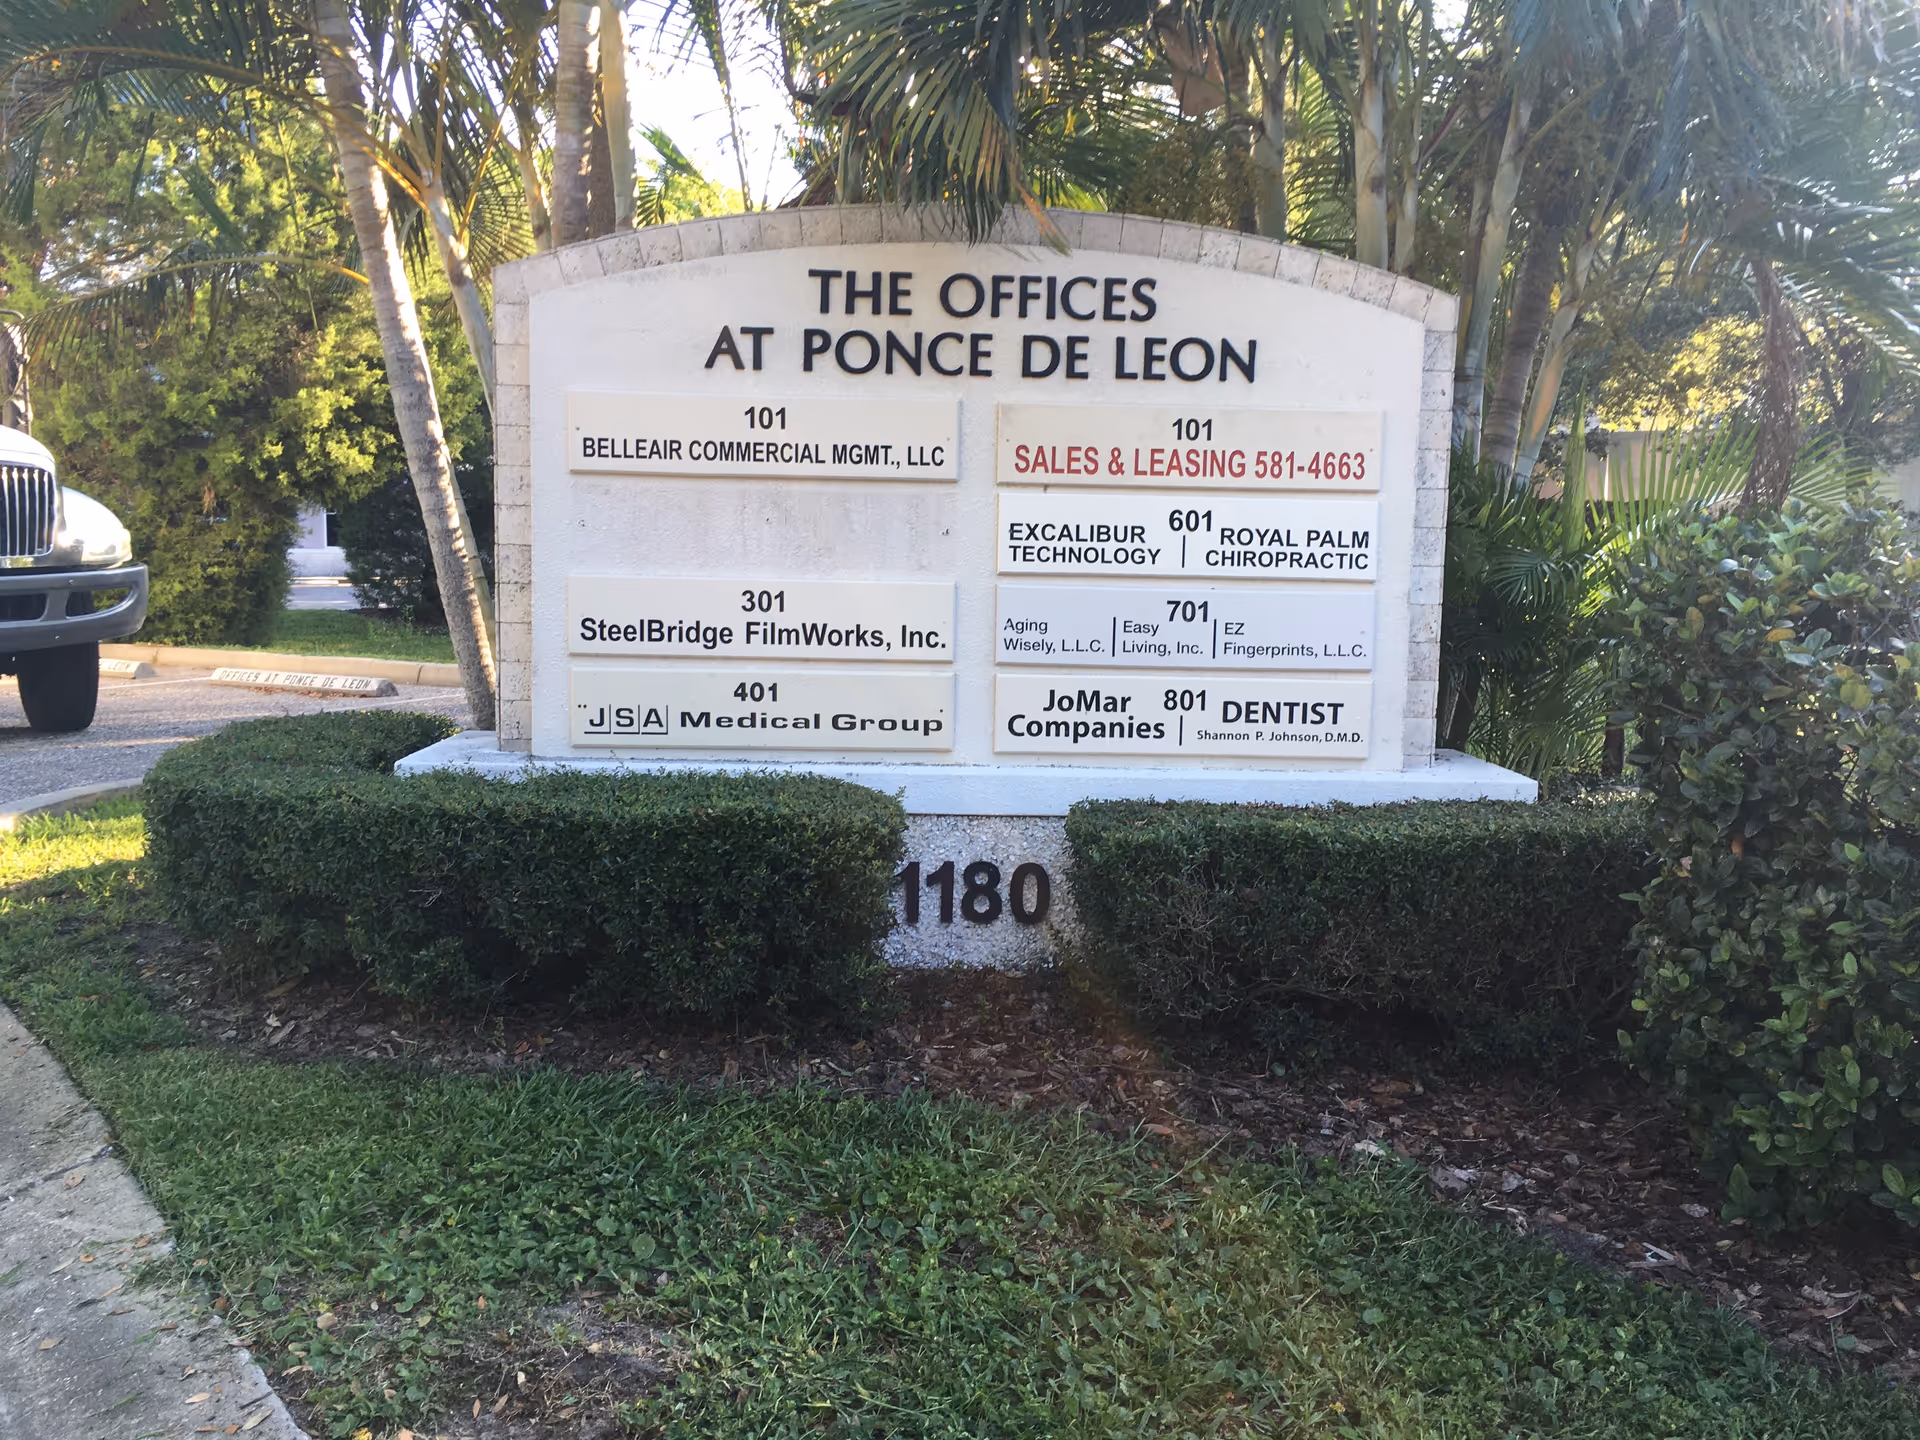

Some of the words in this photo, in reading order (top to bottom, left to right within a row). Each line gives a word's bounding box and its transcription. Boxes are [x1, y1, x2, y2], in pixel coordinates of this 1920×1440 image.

[807, 268, 913, 317] THE
[938, 272, 1157, 323] OFFICES
[704, 325, 775, 372] AT
[802, 328, 994, 378] PONCE
[1021, 334, 1090, 380] DE
[1114, 336, 1258, 384] LEON
[744, 406, 786, 430] 101
[1172, 417, 1213, 442] 101
[582, 437, 683, 461] BELLEAIR
[688, 439, 826, 464] COMMERCIAL
[832, 443, 901, 470] MGMT.,
[907, 445, 945, 467] LLC
[1014, 444, 1099, 476] SALES
[1107, 446, 1126, 476] &
[1133, 447, 1246, 479] LEASING
[1254, 450, 1365, 481] 581-4663
[1008, 522, 1146, 544] EXCALIBUR
[1168, 509, 1212, 533] 601
[1220, 527, 1299, 547] ROYAL
[1306, 529, 1370, 549] PALM
[1008, 545, 1162, 565] TECHNOLOGY
[1205, 549, 1369, 570] CHIROPRACTIC
[741, 589, 785, 613] 301
[1166, 600, 1209, 623] 701
[580, 617, 734, 650] SteelBridge
[745, 621, 891, 652] FilmWorks,
[901, 624, 946, 649] Inc.
[1003, 617, 1048, 635] Aging
[1123, 620, 1160, 637] Easy
[1224, 622, 1245, 636] EZ
[1003, 637, 1056, 655] Wisely,
[1061, 638, 1105, 653] L.L.C.
[1122, 639, 1171, 657] Living,
[1176, 641, 1204, 655] Inc.
[1223, 641, 1318, 659] Fingerprints,
[1323, 643, 1367, 658] L.L.C.
[220, 670, 260, 682] OFFICES
[265, 673, 279, 682] AT
[283, 675, 315, 687] PONCE
[322, 677, 338, 687] DE
[342, 679, 371, 689] LEON
[733, 681, 778, 703] 401
[1042, 689, 1132, 713] JoMar
[1163, 688, 1206, 712] 801
[680, 711, 821, 730] Medical
[831, 713, 943, 737] Group
[1222, 700, 1345, 725] DENTIST
[1007, 713, 1165, 744] Companies
[1197, 729, 1250, 741] Shannon
[1255, 730, 1265, 741] P.
[1268, 731, 1323, 744] Johnson,
[1324, 732, 1364, 743] D.M.D.
[895, 861, 1050, 924] 1180
